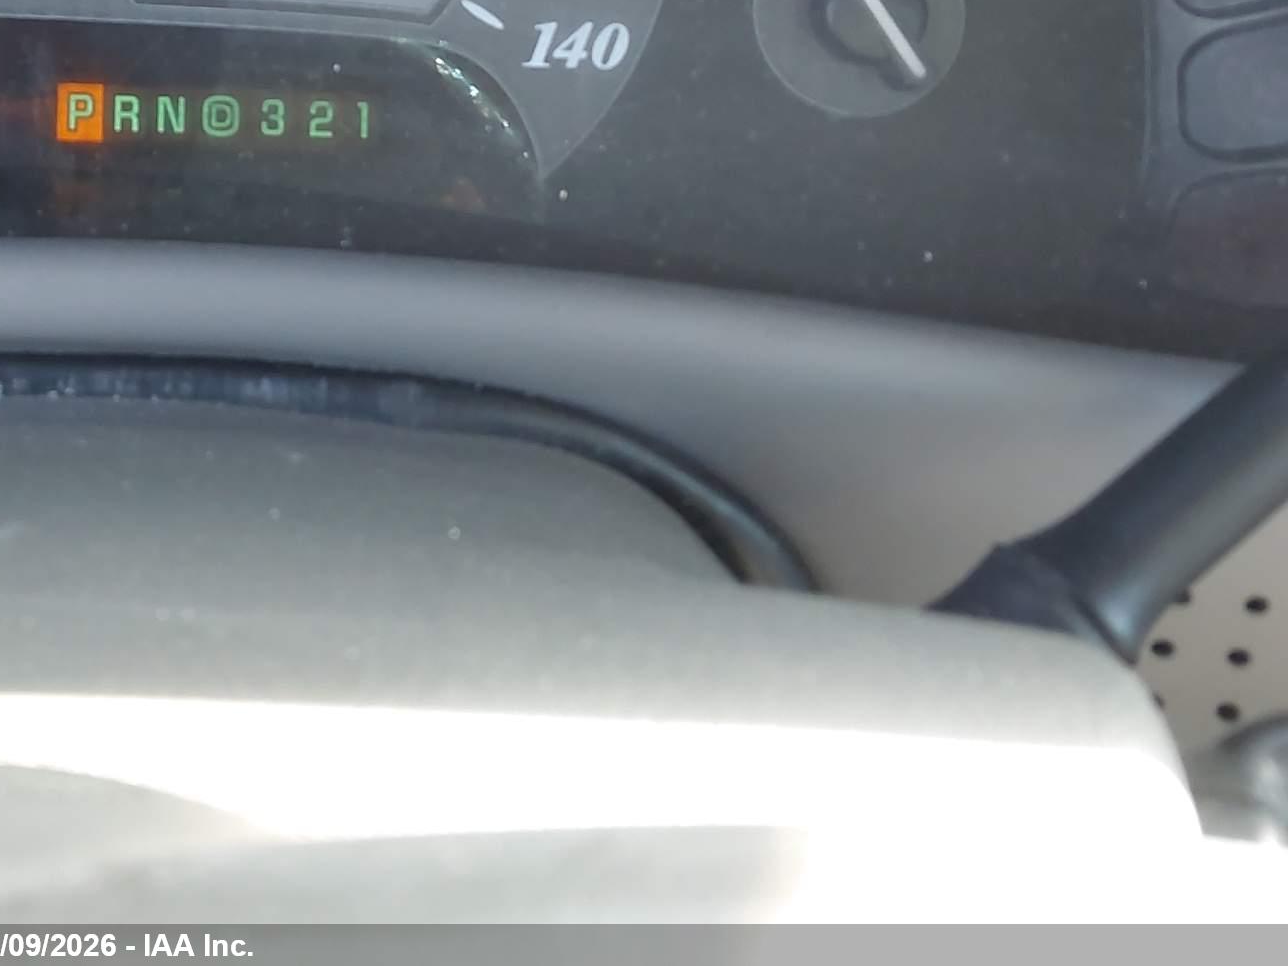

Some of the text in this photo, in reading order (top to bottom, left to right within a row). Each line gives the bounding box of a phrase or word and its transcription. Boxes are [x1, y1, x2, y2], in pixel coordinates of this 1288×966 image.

[522, 22, 630, 69] 140
[68, 95, 93, 131] P
[114, 95, 139, 131] R
[157, 96, 185, 132] N
[260, 100, 285, 135] 3
[310, 101, 334, 136] 2
[357, 101, 371, 138] 1
